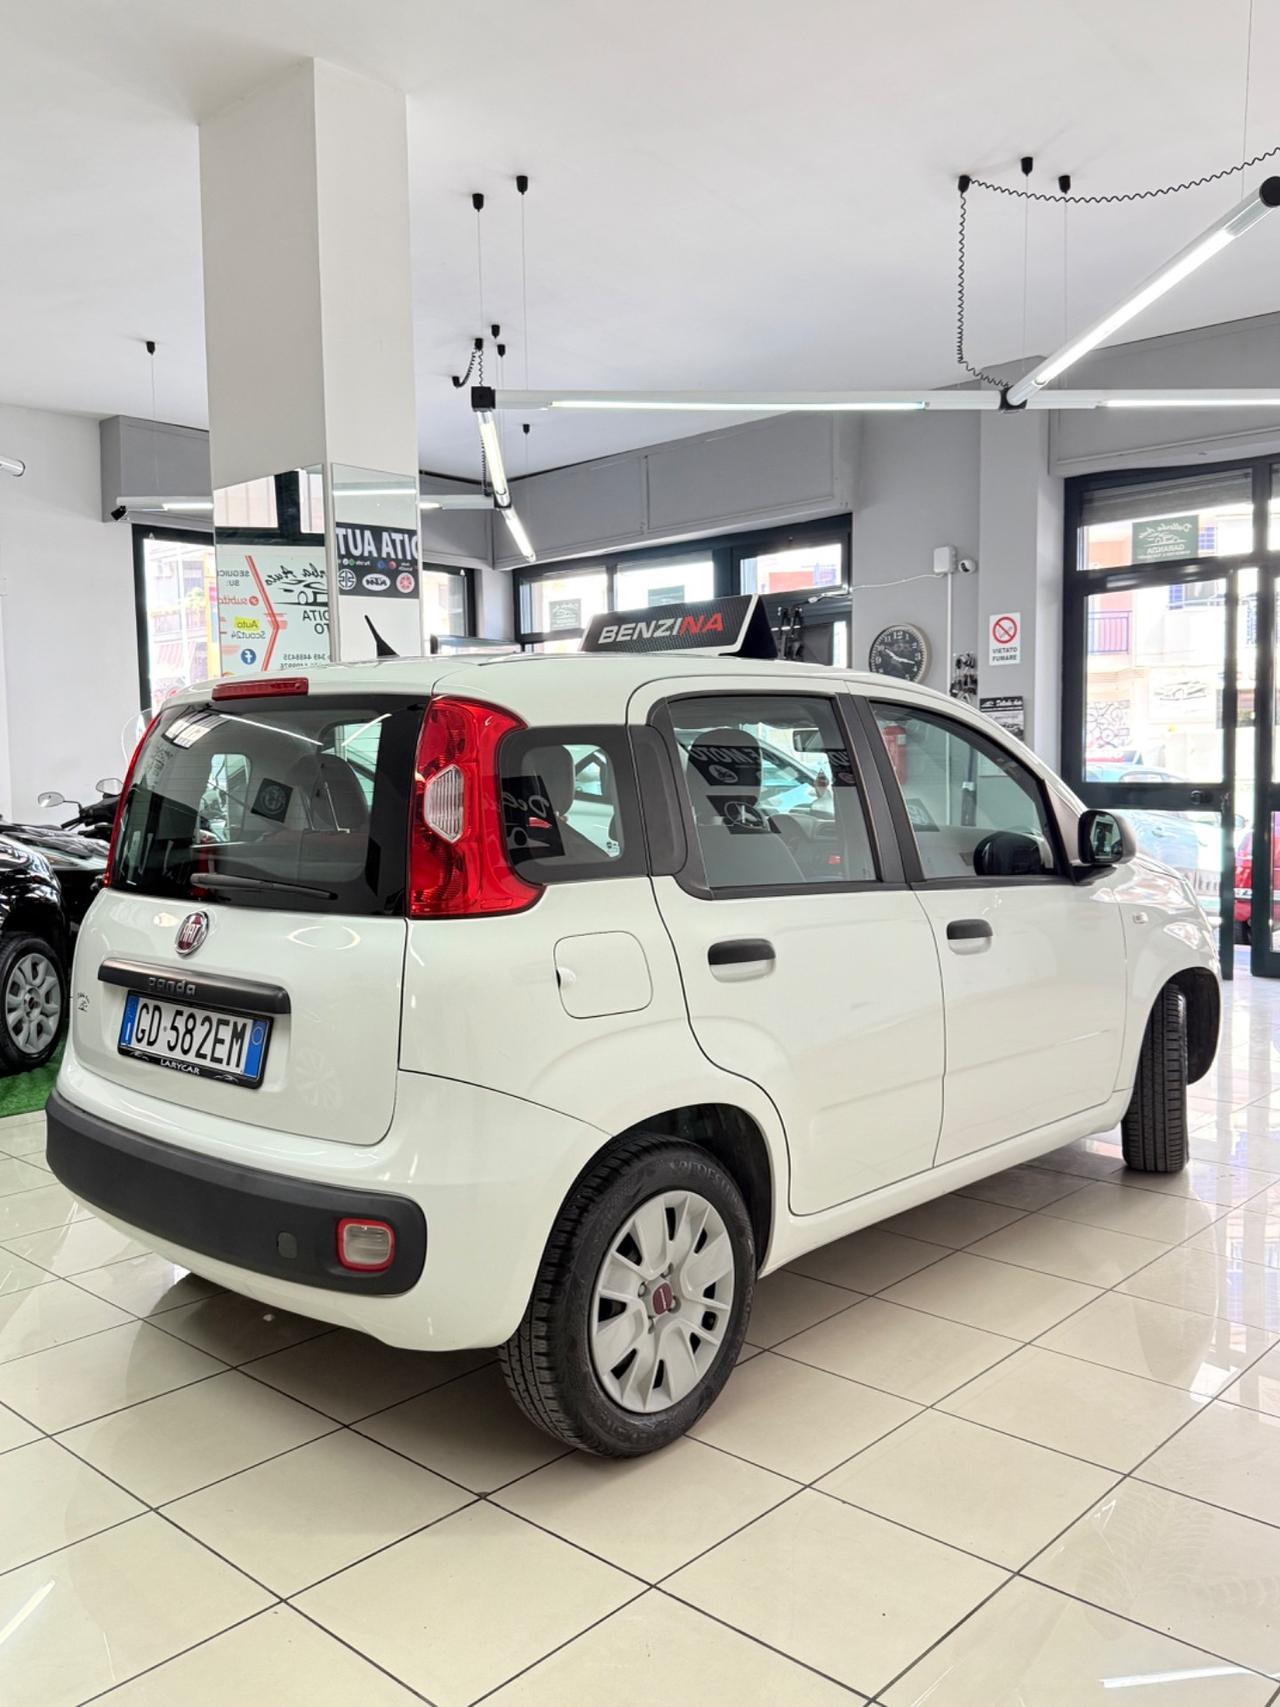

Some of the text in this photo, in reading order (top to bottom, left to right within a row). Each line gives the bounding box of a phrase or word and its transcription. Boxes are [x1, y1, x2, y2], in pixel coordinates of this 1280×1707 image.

[598, 613, 724, 644] BENZINA
[992, 646, 1018, 654] VIETATO
[992, 654, 1017, 662] FUMARE
[179, 922, 201, 943] FIAT
[148, 977, 196, 995] panda
[135, 1002, 247, 1069] GD 582EM
